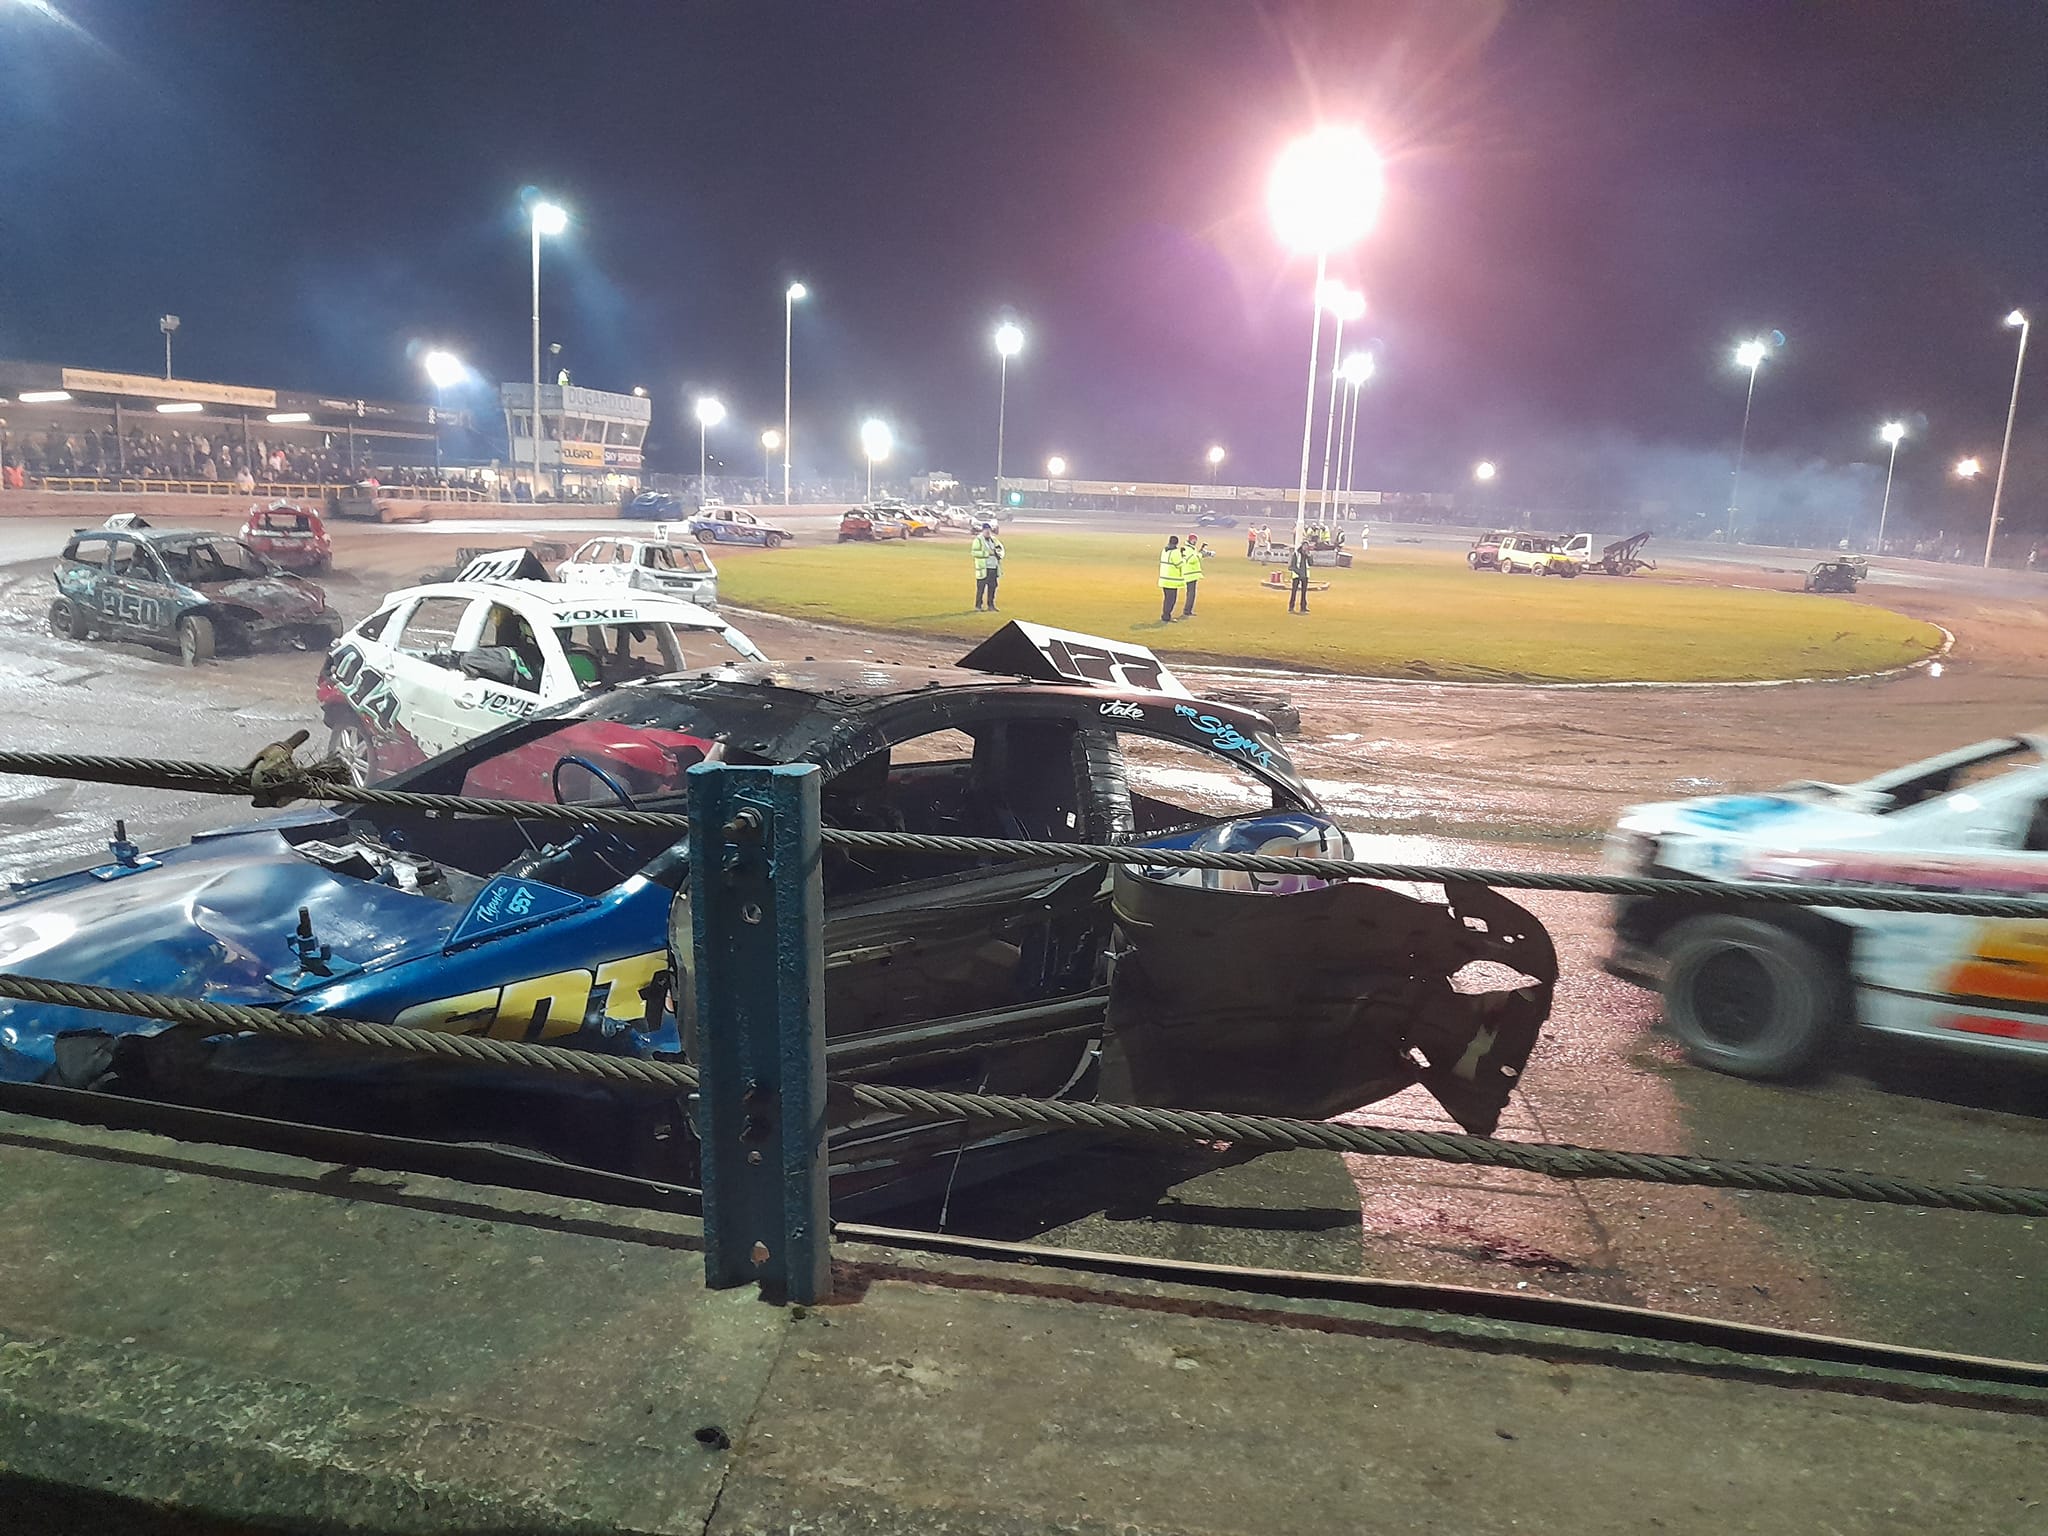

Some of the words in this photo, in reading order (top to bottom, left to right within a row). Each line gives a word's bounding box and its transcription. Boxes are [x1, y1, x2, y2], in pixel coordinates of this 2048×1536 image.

[552, 608, 635, 620] YOXIE
[1040, 638, 1163, 690] 177
[478, 688, 537, 718] YOXIE
[1099, 699, 1145, 721] Jake
